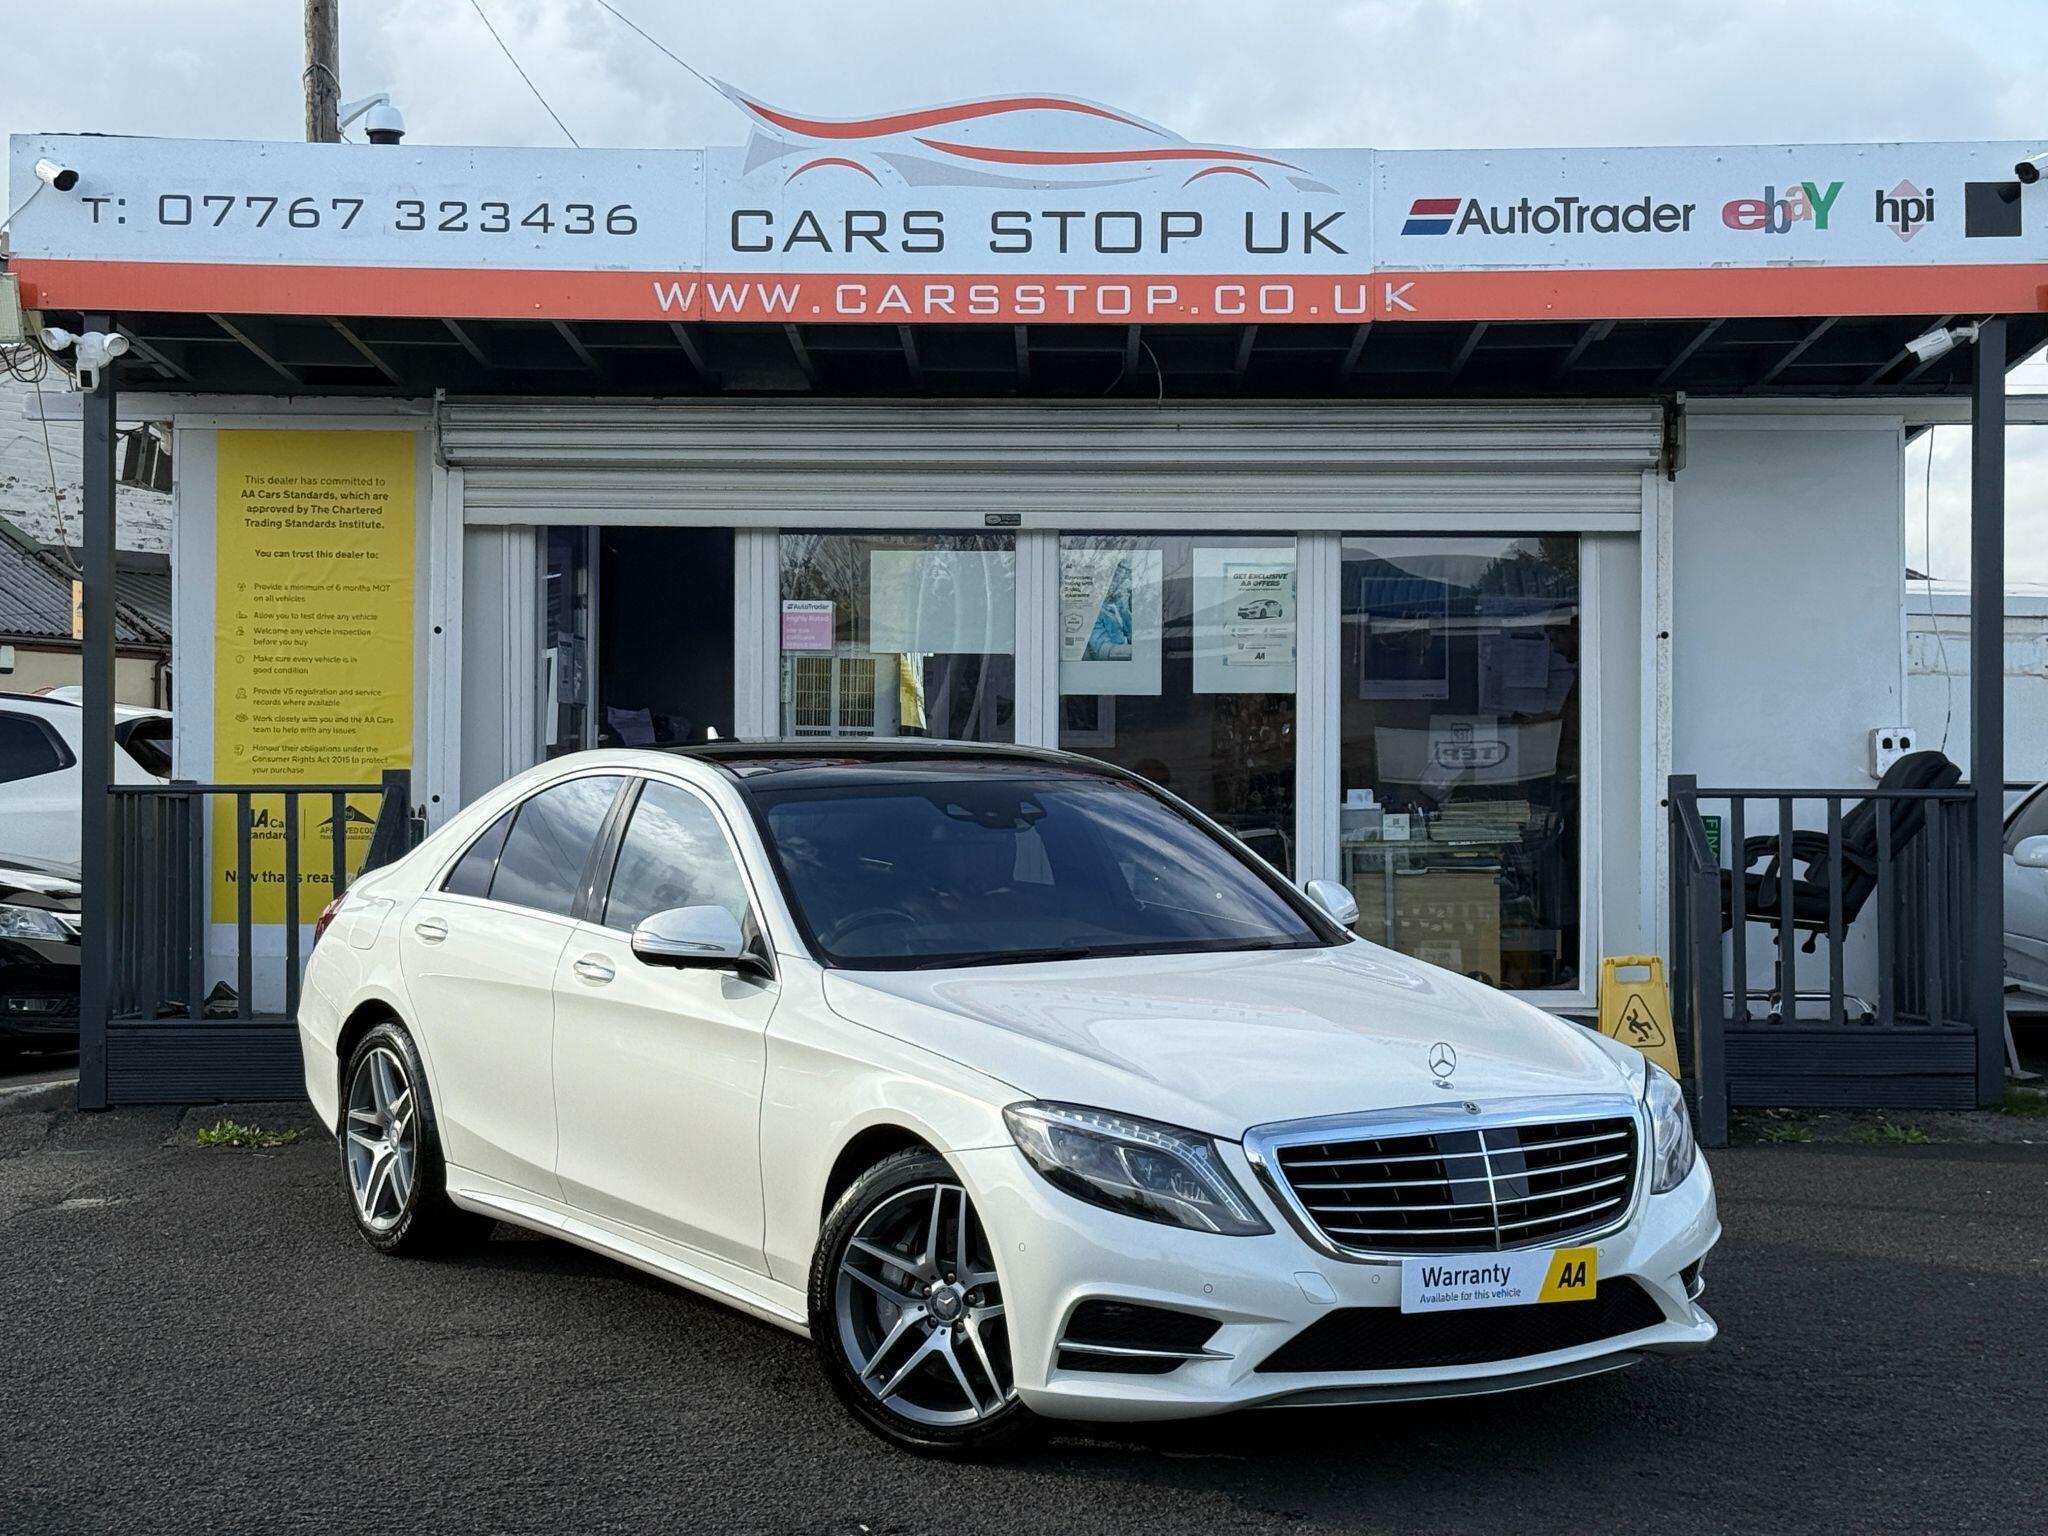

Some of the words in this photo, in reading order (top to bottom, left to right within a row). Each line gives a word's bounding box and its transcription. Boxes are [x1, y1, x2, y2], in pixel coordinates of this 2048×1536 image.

[1875, 187, 1935, 233] hpi
[82, 197, 126, 224] T:
[158, 194, 365, 230] 07767
[394, 199, 639, 236] 323436
[1457, 197, 1696, 234] AutoTrader
[731, 209, 945, 253] CARS
[989, 210, 1203, 254] STOP
[1245, 211, 1350, 254] UK
[245, 475, 265, 484] This
[268, 476, 297, 485] dealer
[301, 476, 317, 485] has
[321, 477, 372, 486] committed
[376, 478, 385, 486] to
[241, 490, 255, 498] AA
[258, 490, 281, 499] Cars
[283, 491, 337, 500] Standards,
[340, 491, 369, 500] which
[247, 505, 293, 514] approved
[297, 505, 308, 515] by
[311, 505, 329, 514] The
[332, 506, 382, 514] Chartered
[245, 519, 282, 529] Trading
[285, 519, 336, 528] Standards
[340, 520, 384, 529] Institute.
[293, 550, 314, 558] trust
[317, 550, 333, 558] this
[336, 550, 364, 559] dealer
[367, 551, 378, 559] to:
[276, 613, 289, 621] you
[337, 614, 349, 622] any
[333, 628, 371, 637] inspection
[294, 639, 308, 647] buy
[254, 655, 273, 663] Make
[315, 656, 340, 664] vehicle
[1254, 652, 1265, 660] AA
[295, 689, 337, 697] registration
[274, 716, 299, 724] closely
[361, 757, 388, 765] protect
[270, 767, 304, 775] purchase
[1421, 1263, 1511, 1288] Warranty
[1557, 1261, 1587, 1288] AA
[1420, 1293, 1458, 1304] Available
[1460, 1291, 1472, 1301] for
[1474, 1289, 1490, 1300] this
[1491, 1287, 1522, 1299] vehicle
